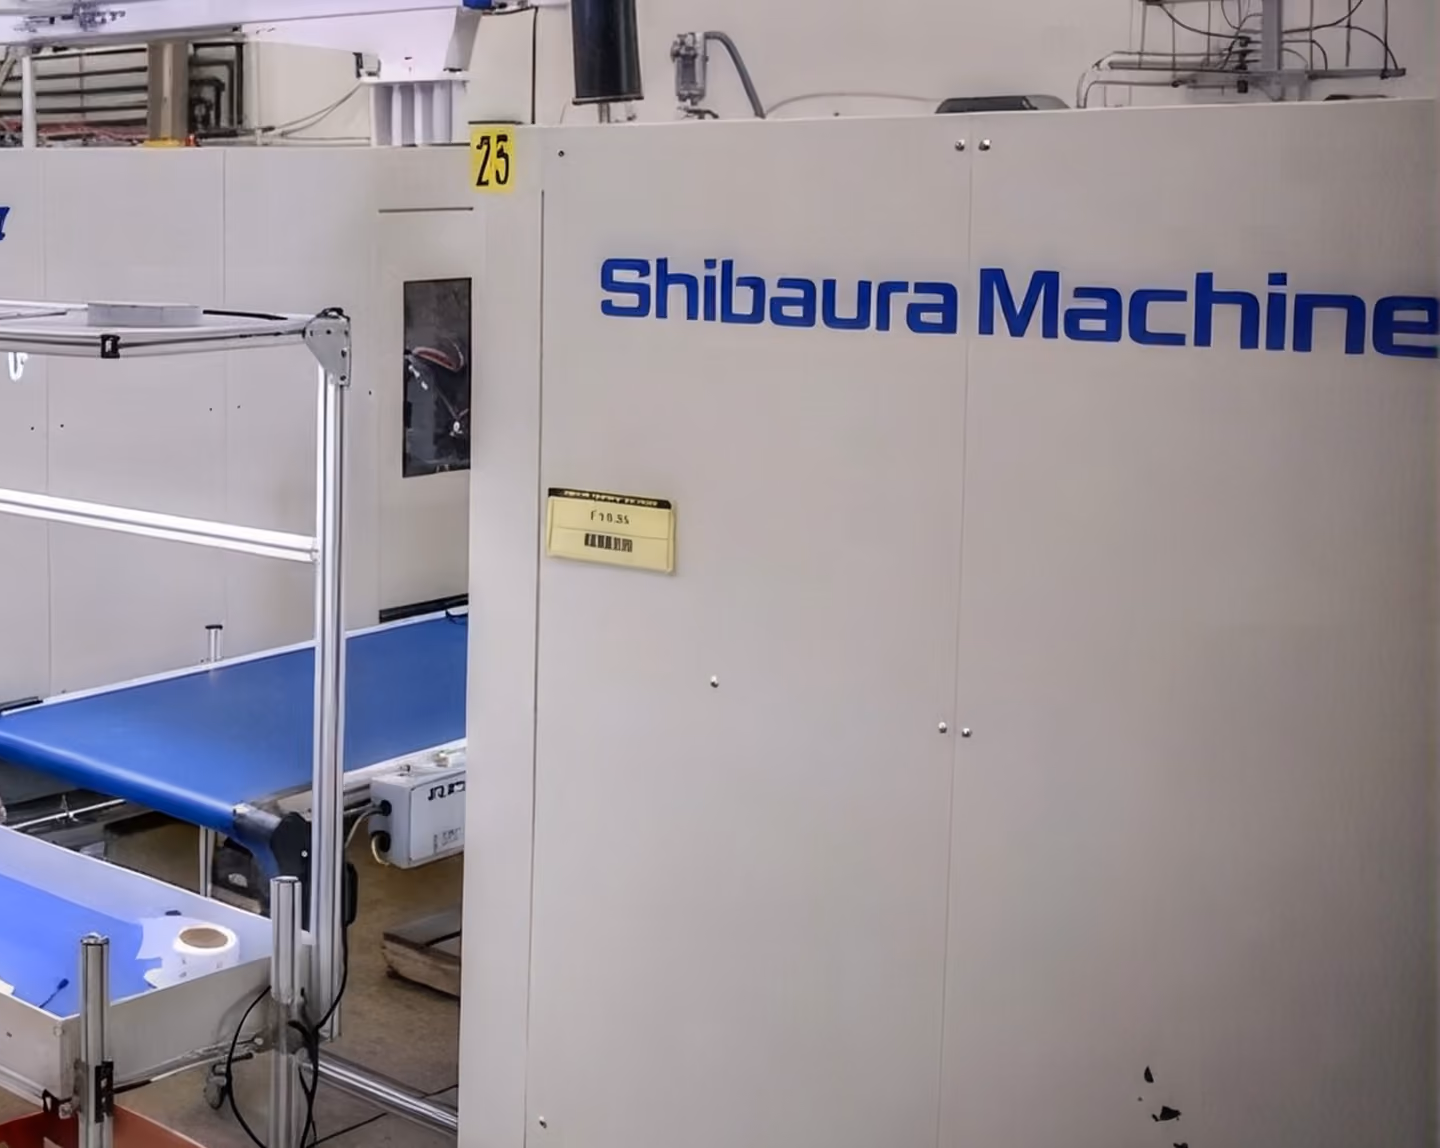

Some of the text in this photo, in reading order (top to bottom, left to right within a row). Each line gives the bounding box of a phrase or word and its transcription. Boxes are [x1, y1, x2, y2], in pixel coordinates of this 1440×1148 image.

[475, 133, 510, 187] 25
[600, 257, 1440, 359] Shibaura Machine
